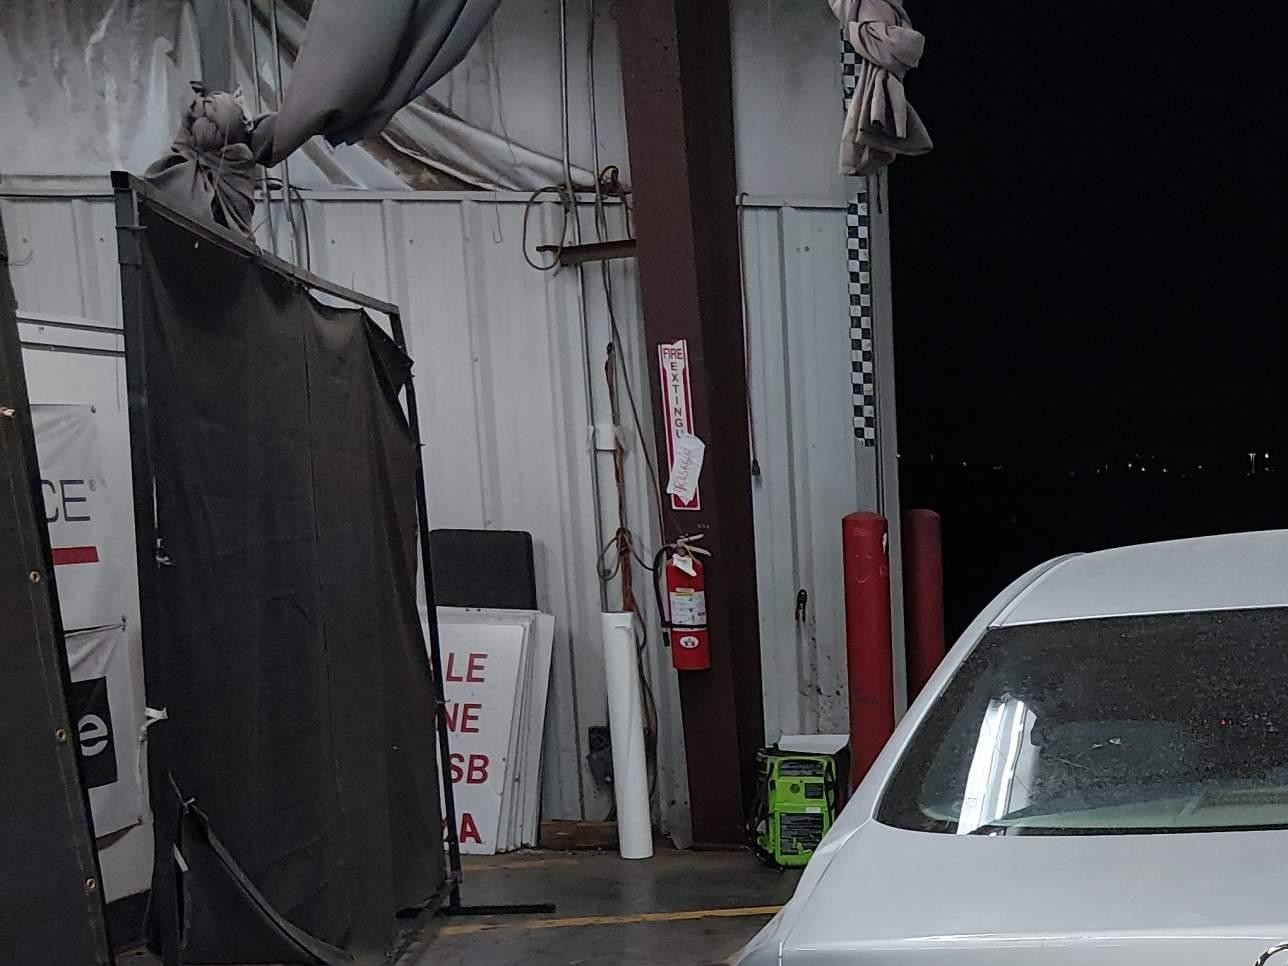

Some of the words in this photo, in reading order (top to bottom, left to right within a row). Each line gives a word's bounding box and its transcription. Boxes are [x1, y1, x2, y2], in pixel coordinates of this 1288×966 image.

[663, 347, 684, 360] FIRE
[445, 652, 488, 683] LE
[458, 812, 483, 844] A
